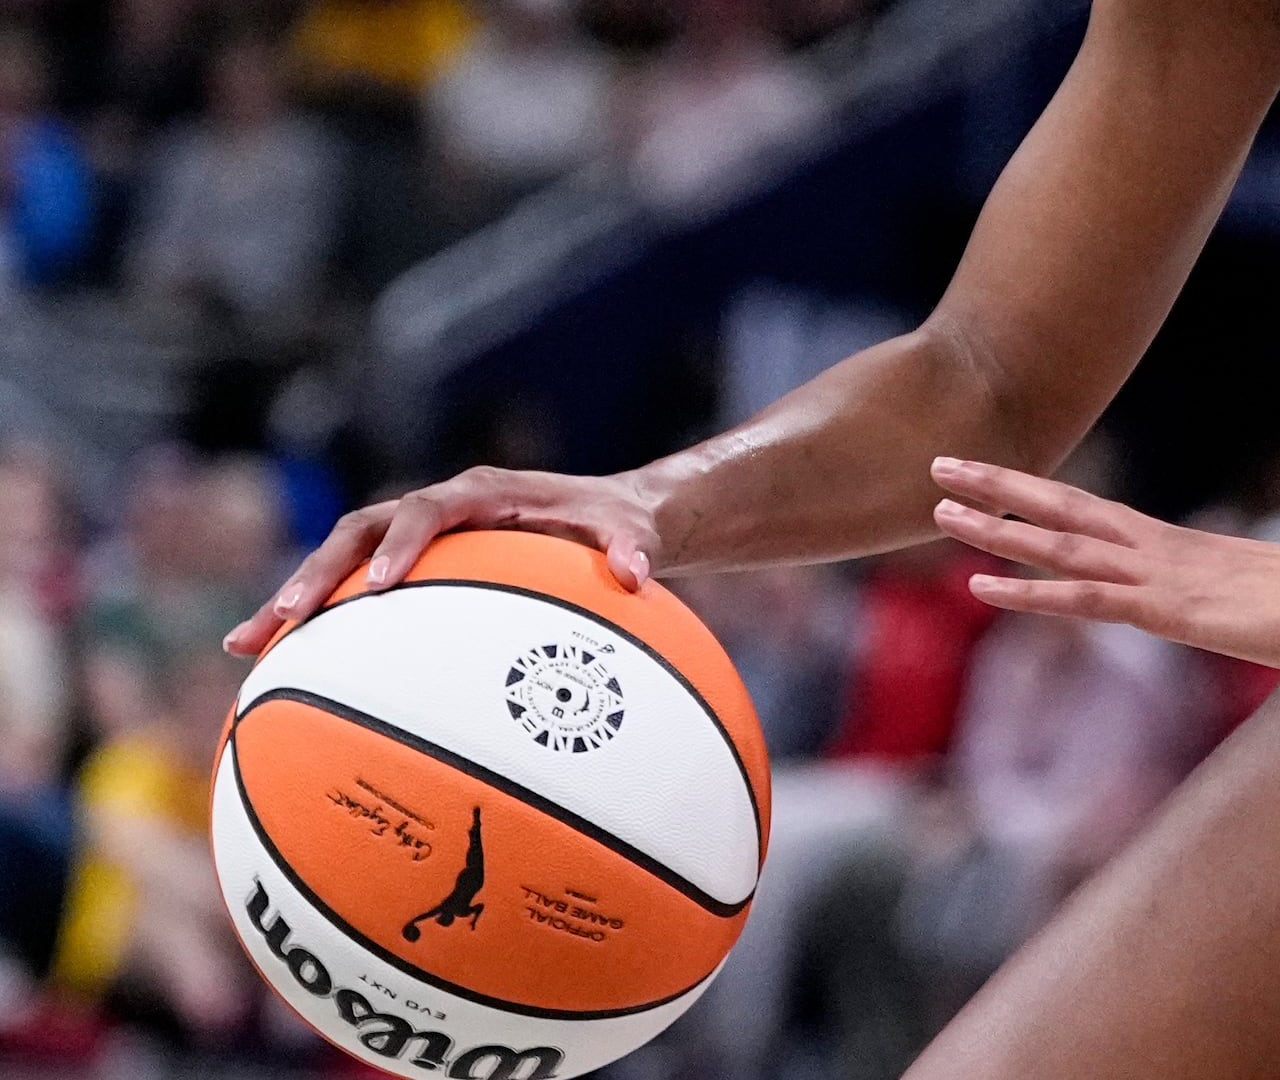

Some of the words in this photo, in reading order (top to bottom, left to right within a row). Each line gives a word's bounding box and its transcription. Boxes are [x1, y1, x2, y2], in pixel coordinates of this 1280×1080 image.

[520, 886, 568, 913] BALL
[526, 906, 605, 942] OFFICIAL
[571, 906, 624, 930] GAME
[246, 875, 567, 1080] Wilson
[358, 974, 397, 1000] NXT
[405, 999, 447, 1021] EVO
